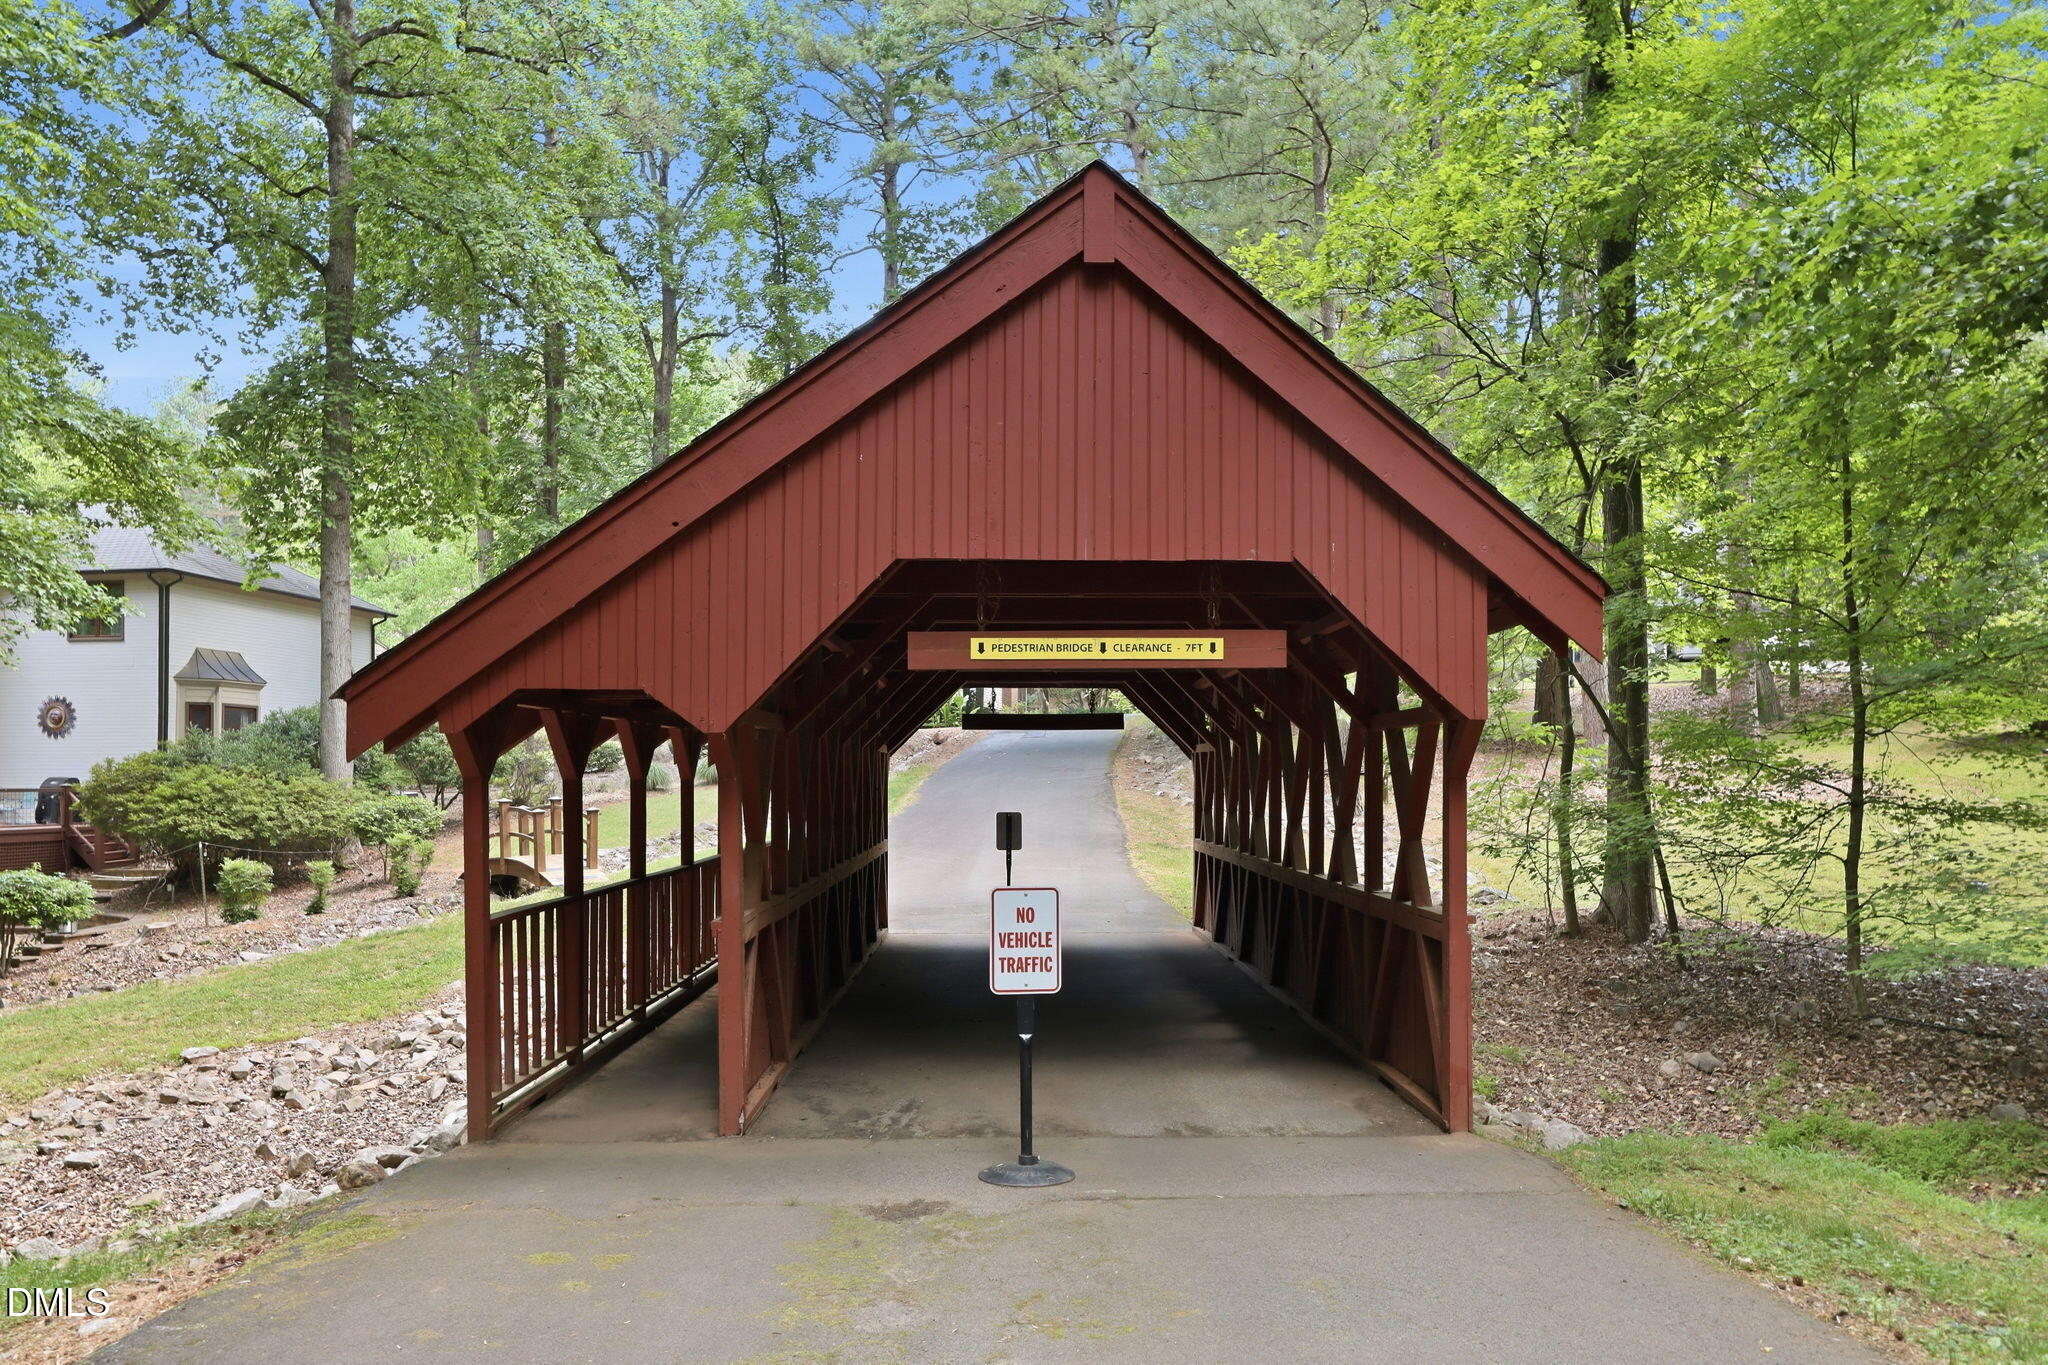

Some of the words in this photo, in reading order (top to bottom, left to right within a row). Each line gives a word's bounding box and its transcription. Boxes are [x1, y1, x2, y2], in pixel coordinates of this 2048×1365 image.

[991, 643, 1054, 653] PEDESTRIAN
[1056, 643, 1093, 653] BRIDGE
[1113, 643, 1172, 653] CLEARANCE
[1185, 643, 1203, 653] 7FT
[1016, 907, 1035, 924] NO
[998, 931, 1053, 949] VEHICLE
[998, 956, 1053, 973] TRAFFIC
